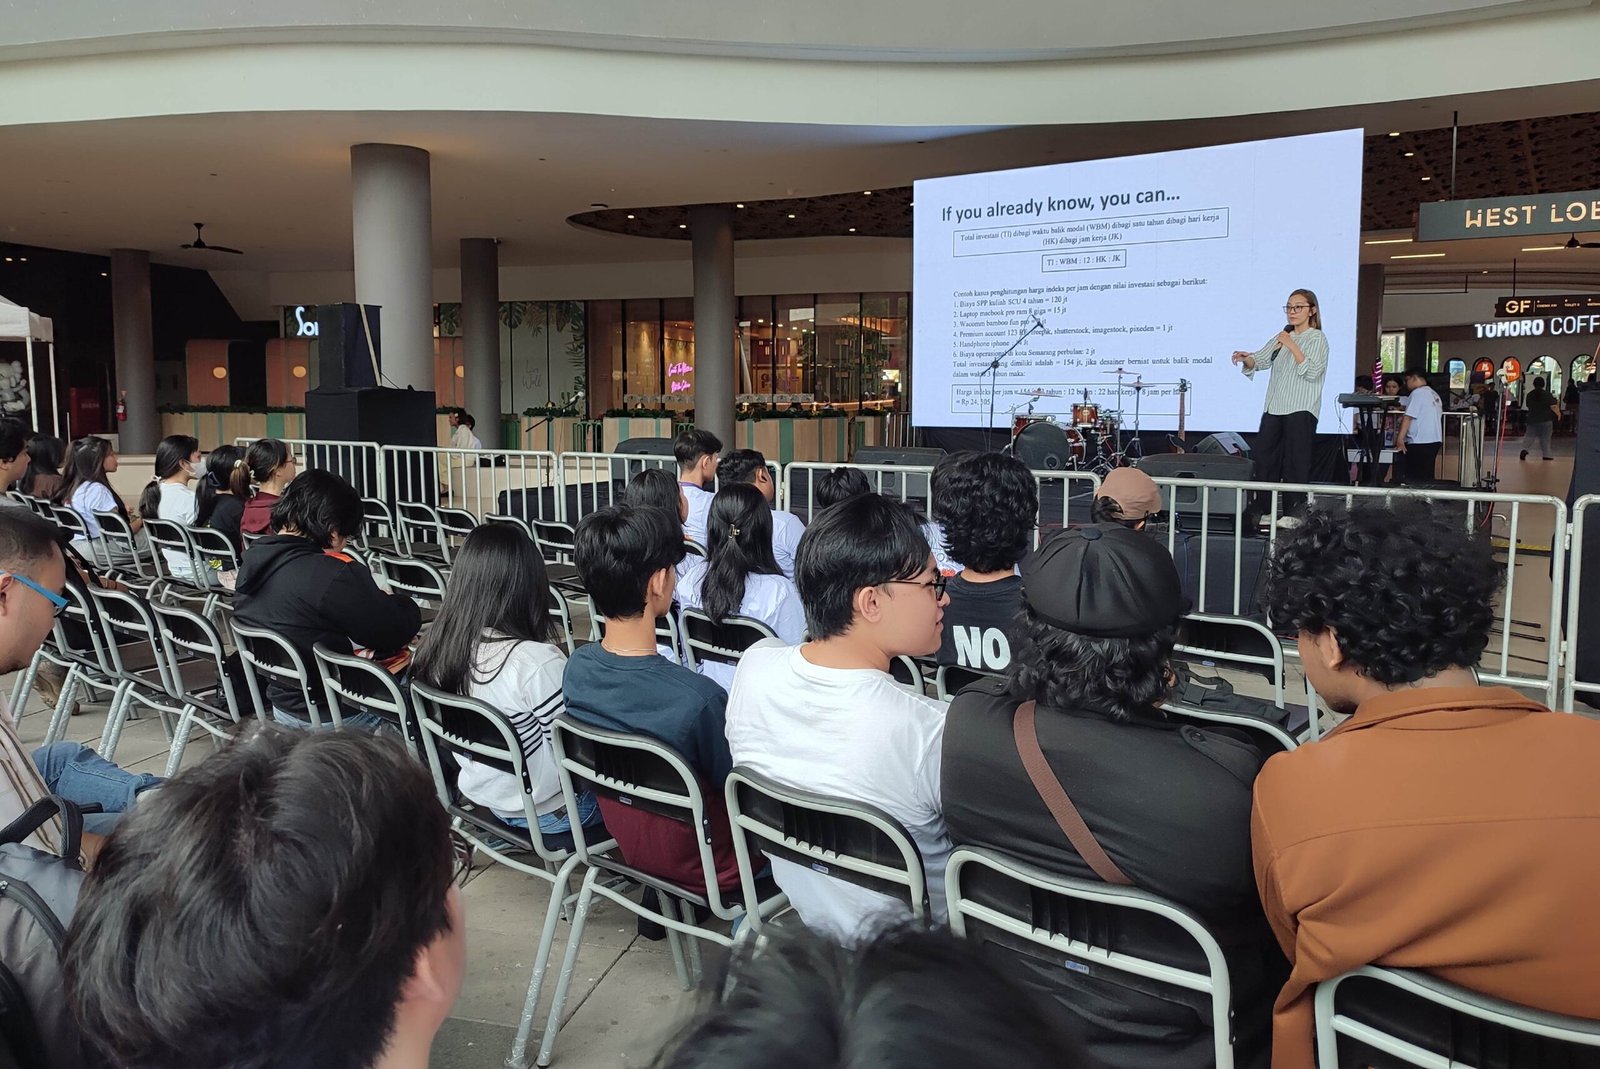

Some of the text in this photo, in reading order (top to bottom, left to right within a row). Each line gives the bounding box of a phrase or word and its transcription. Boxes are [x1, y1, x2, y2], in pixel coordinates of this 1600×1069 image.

[942, 189, 1181, 224] If you already know, you can...
[1465, 205, 1537, 228] WEST
[961, 233, 975, 241] Total
[976, 231, 1000, 240] investasi
[1000, 230, 1012, 239] (TI)
[1013, 229, 1031, 238] dibagi
[1032, 227, 1050, 235] waktu
[1051, 226, 1066, 234] balik
[1067, 224, 1085, 233] modal
[1086, 222, 1111, 231] (WBM)
[1112, 220, 1131, 230] dibagi
[1147, 218, 1165, 226] tahun
[1166, 216, 1187, 225] dibagi
[1188, 215, 1201, 223] hari
[1202, 213, 1220, 223] kerja
[1042, 232, 1122, 246] (HK) dibagi jam kerja (JK)
[1059, 257, 1078, 266] WBM
[1083, 256, 1091, 264] 12
[1096, 255, 1107, 263] HK
[1112, 254, 1121, 262] JK
[974, 289, 990, 297] kasus
[990, 287, 1028, 298] penghitungan
[1029, 286, 1045, 295] harga
[1046, 285, 1065, 293] indeks
[1066, 284, 1076, 294] per
[1076, 284, 1089, 293] jam
[1090, 282, 1111, 292] dengan
[1113, 281, 1127, 289] nilai
[1128, 280, 1155, 288] investasi
[1156, 278, 1180, 288] sebagai
[1182, 277, 1208, 287] berikut:
[960, 300, 976, 309] Biaya
[976, 299, 989, 307] SPP
[989, 297, 1007, 306] kuliah
[1008, 297, 1021, 305] SCU
[1028, 296, 1044, 304] tahun
[1051, 295, 1061, 303] 120
[1505, 300, 1531, 314] GF
[960, 310, 979, 320] Laptop
[980, 308, 1004, 317] macbook
[1005, 308, 1015, 318] pro
[1034, 307, 1047, 317] giga
[1053, 306, 1060, 314] 15
[986, 317, 1008, 327] bamboo
[1009, 318, 1020, 326] fun
[1475, 319, 1545, 338] TOMORO
[960, 329, 983, 338] Premium
[984, 329, 1006, 338] account
[1007, 328, 1018, 337] 123
[1092, 325, 1128, 335] imagestock,
[1129, 324, 1155, 334] pixeden
[960, 339, 991, 349] Handphone
[991, 339, 1010, 349] iphone
[960, 350, 975, 359] Biaya
[1028, 348, 1056, 358] Semarang
[953, 360, 967, 368] Total
[1010, 359, 1032, 367] dimiliki
[1035, 358, 1054, 367] adalah
[1063, 358, 1074, 366] 154
[1085, 357, 1097, 367] jika
[1099, 357, 1125, 365] desainer
[1127, 357, 1149, 365] berniat
[1151, 357, 1170, 365] untuk
[1191, 356, 1214, 364] modal
[953, 369, 969, 378] dalam
[1008, 369, 1027, 377] maka:
[956, 388, 972, 397] Harga
[1002, 388, 1014, 397] jam
[1068, 388, 1076, 396] 12
[1098, 388, 1106, 396] 22
[1147, 389, 1160, 397] jam
[1161, 389, 1172, 397] per
[961, 398, 970, 407] Rp
[953, 625, 1011, 670] NO
